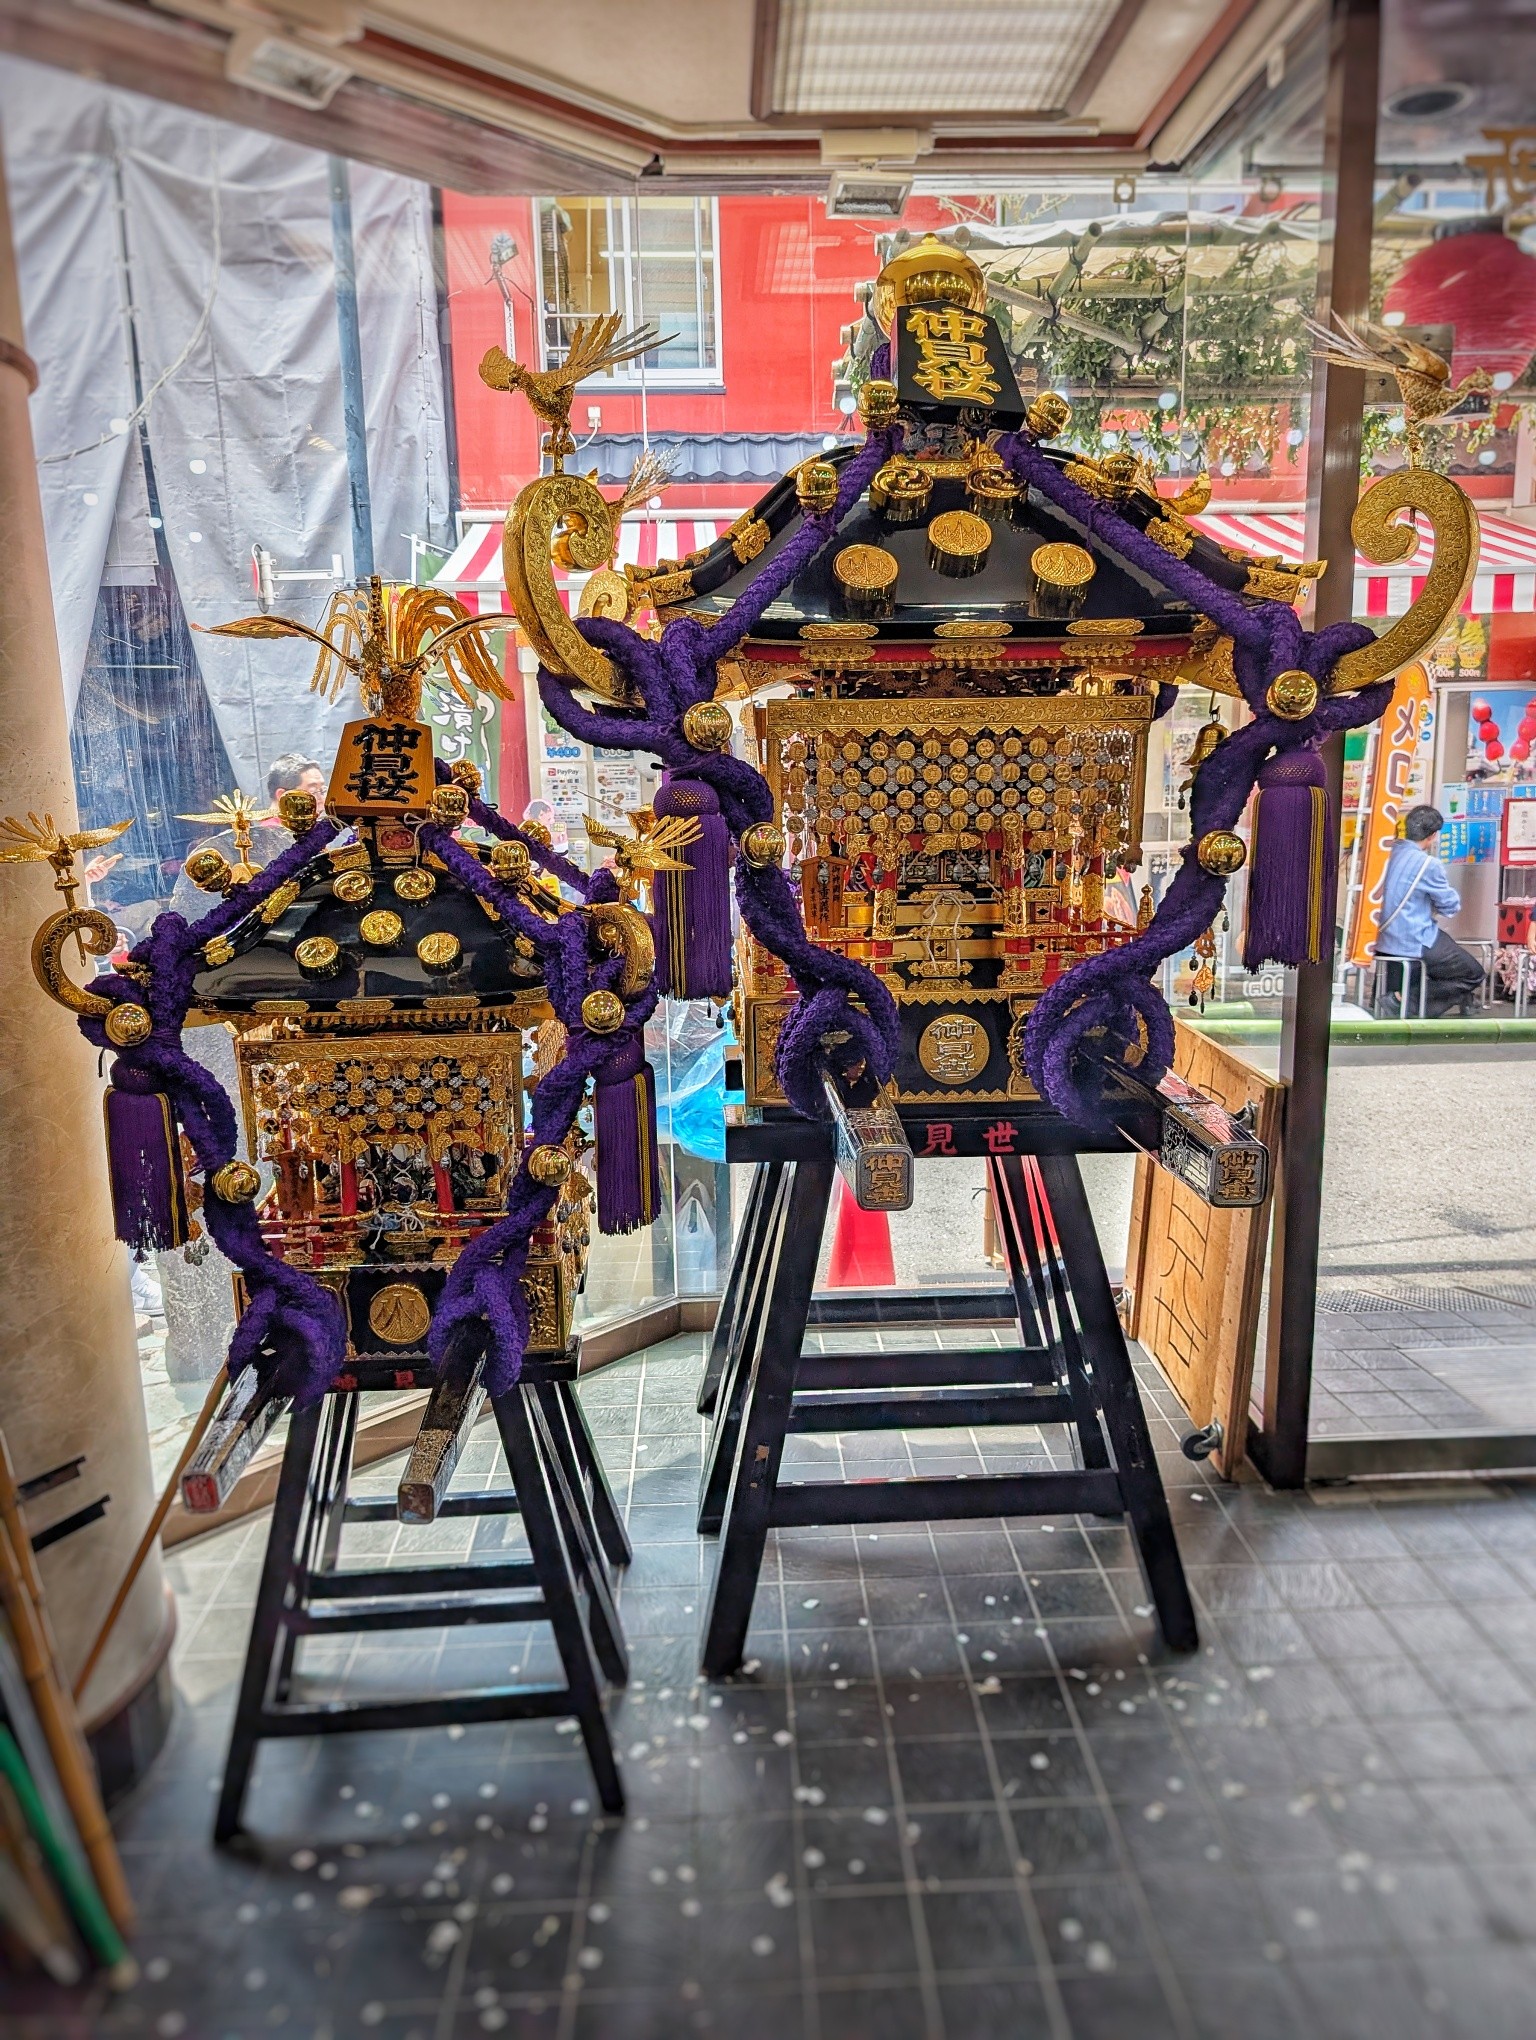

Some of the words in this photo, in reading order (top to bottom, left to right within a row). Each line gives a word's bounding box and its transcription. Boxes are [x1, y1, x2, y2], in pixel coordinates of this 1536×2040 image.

[905, 306, 1003, 406] 仲見世
[343, 722, 423, 804] 仲見世
[546, 746, 581, 758] ¥400
